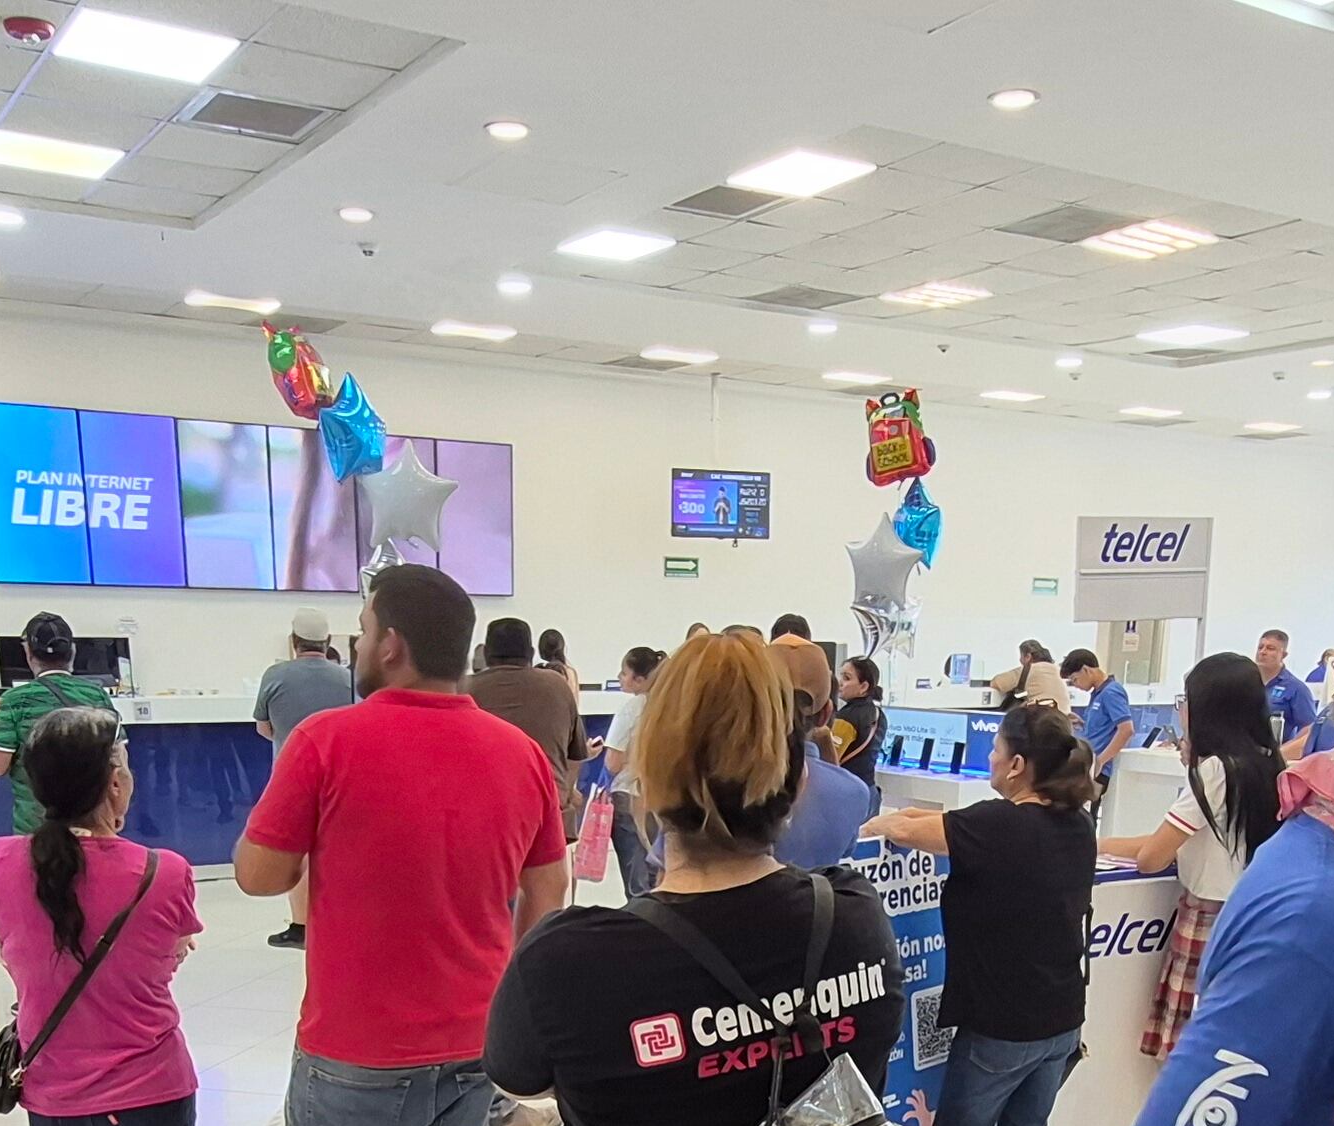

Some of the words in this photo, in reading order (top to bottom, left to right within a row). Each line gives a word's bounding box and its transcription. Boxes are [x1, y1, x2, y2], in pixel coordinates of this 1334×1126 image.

[16, 470, 63, 486] PLAN
[67, 473, 155, 491] INTERNET
[10, 487, 152, 530] LIBRE
[1100, 523, 1191, 562] telcel
[971, 719, 999, 733] vivo
[908, 852, 932, 877] de
[901, 958, 927, 984] sa!
